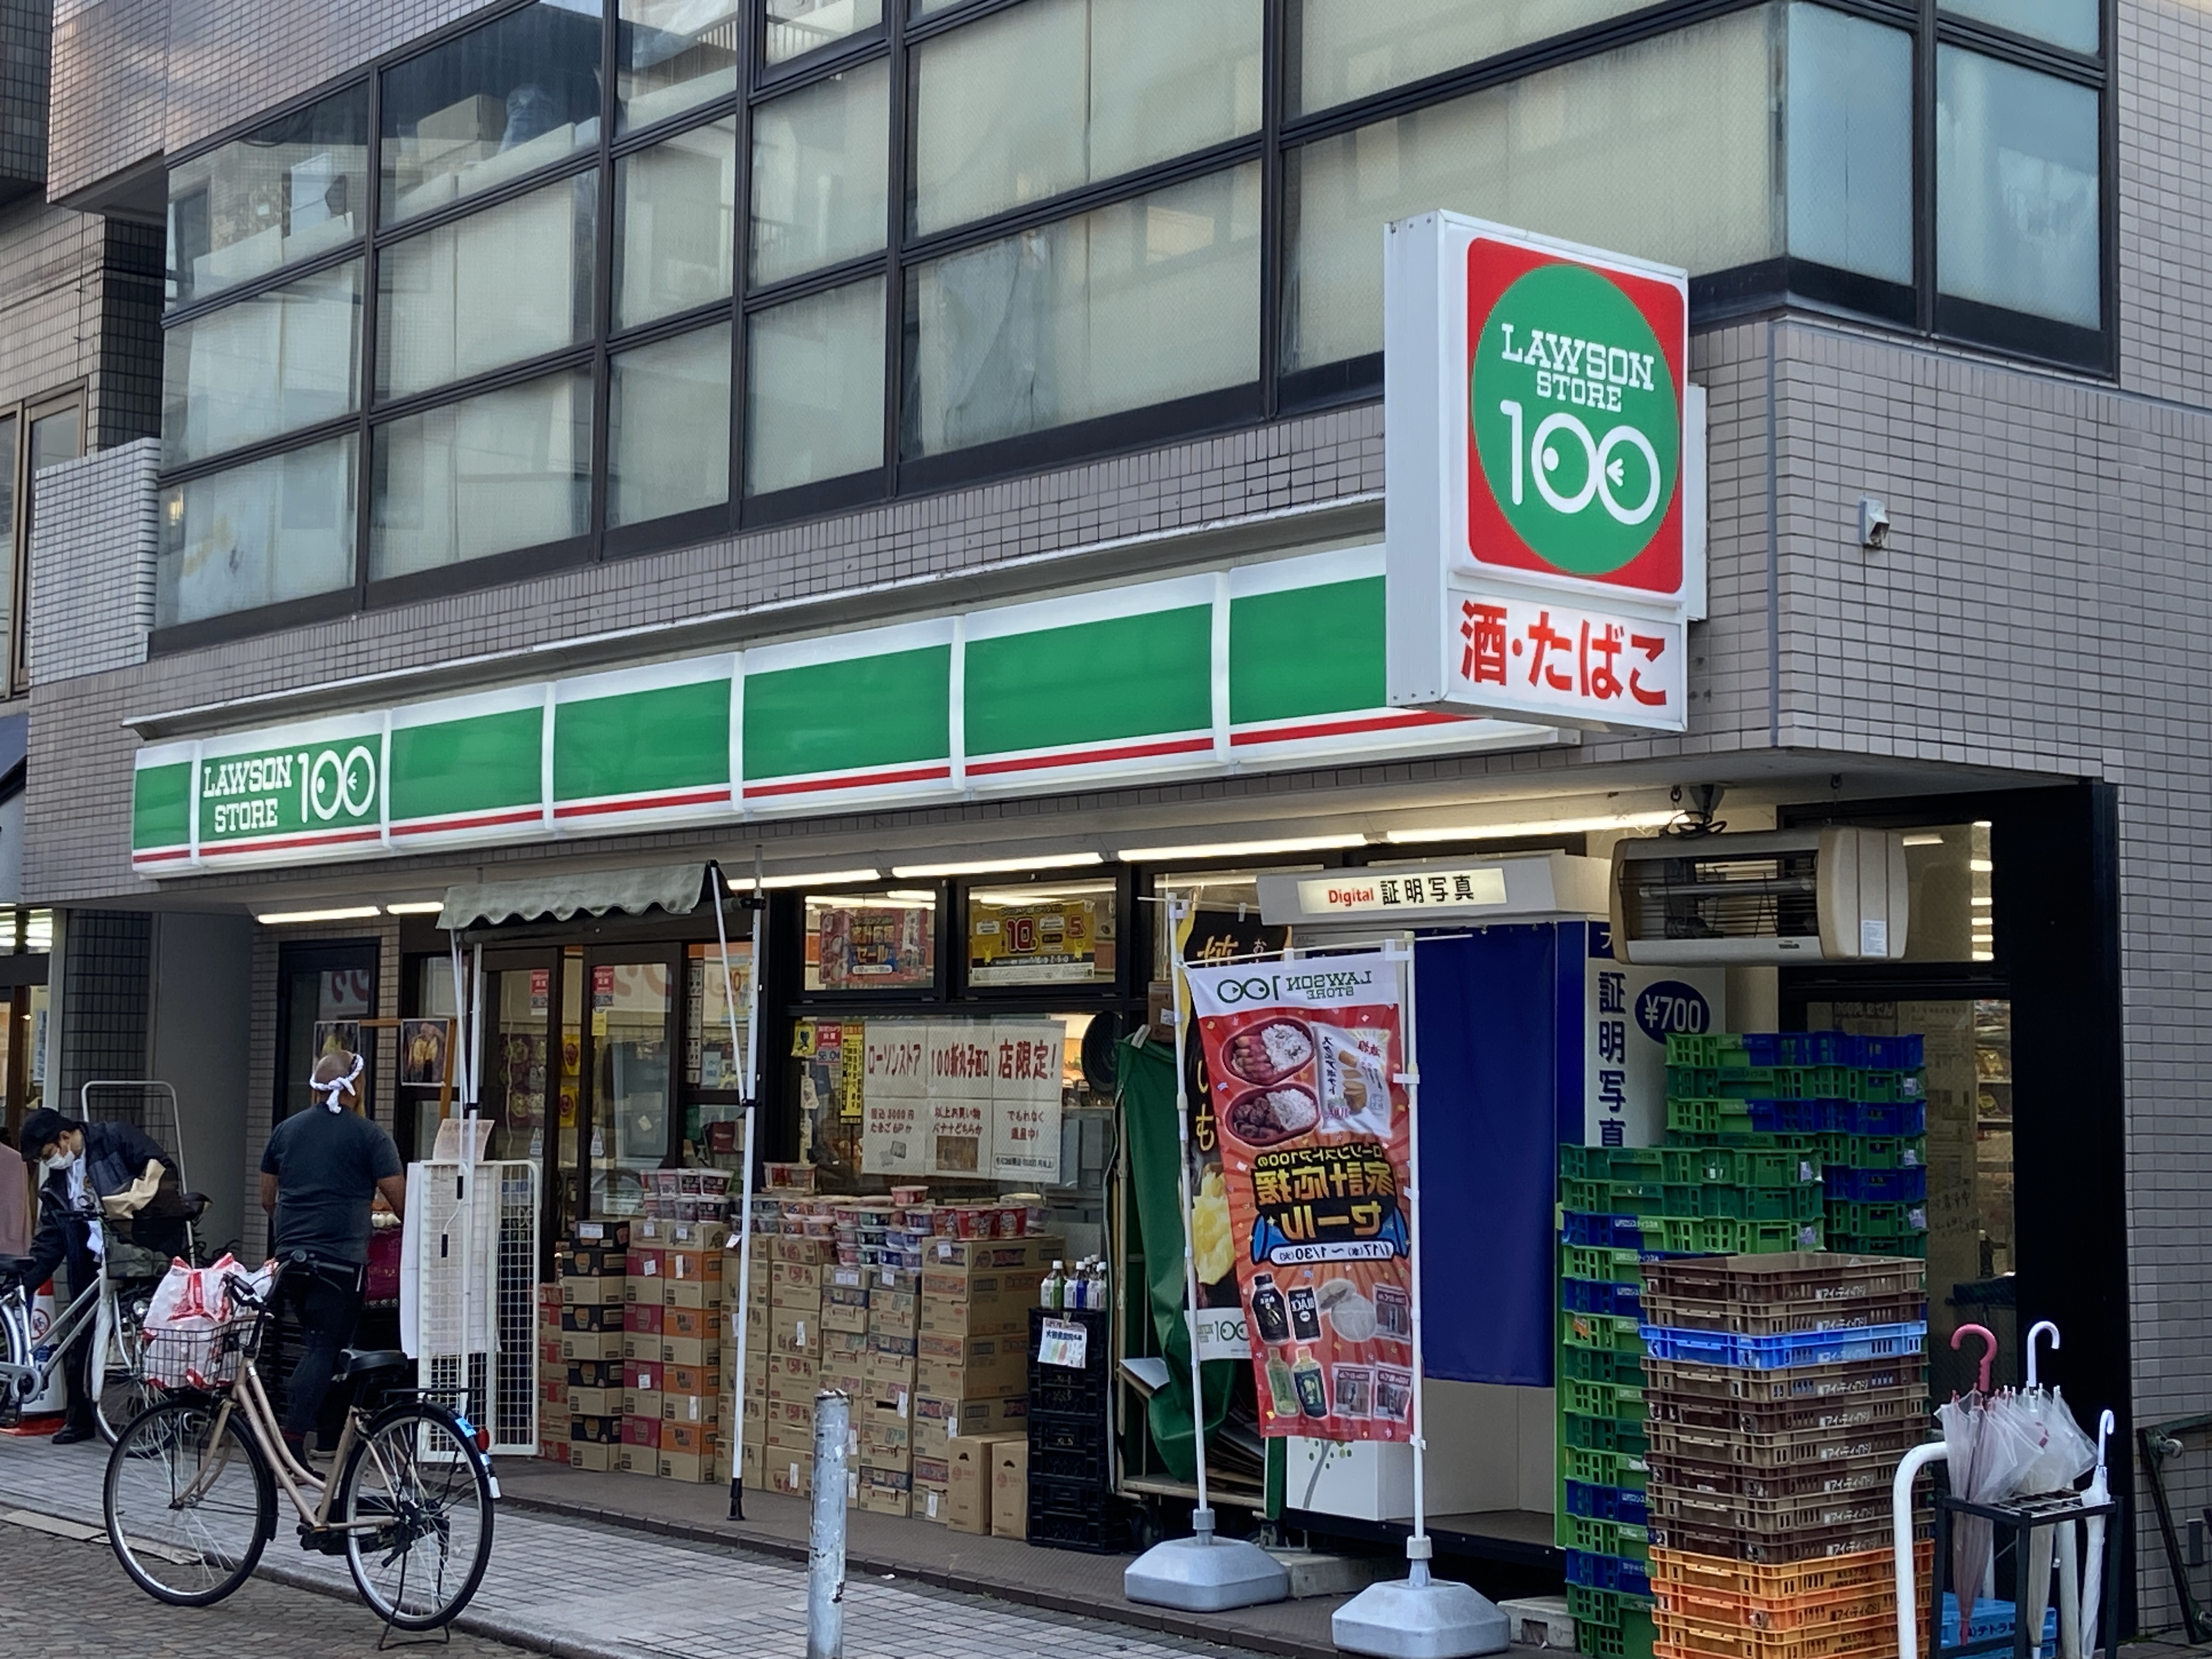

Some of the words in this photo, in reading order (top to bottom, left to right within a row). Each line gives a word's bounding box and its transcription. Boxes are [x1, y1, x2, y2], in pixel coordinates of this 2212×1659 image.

[1501, 323, 1655, 391] LAWSON
[1537, 370, 1622, 413] STORE
[1499, 399, 1661, 525] 100
[1460, 599, 1667, 706] 酒・たばこ
[203, 754, 294, 798] LAWSON
[297, 745, 376, 823] 100
[214, 798, 278, 833] STORE
[1328, 887, 1374, 907] Digital
[1380, 874, 1475, 905] 証明写真
[1645, 994, 1701, 1034] ¥700
